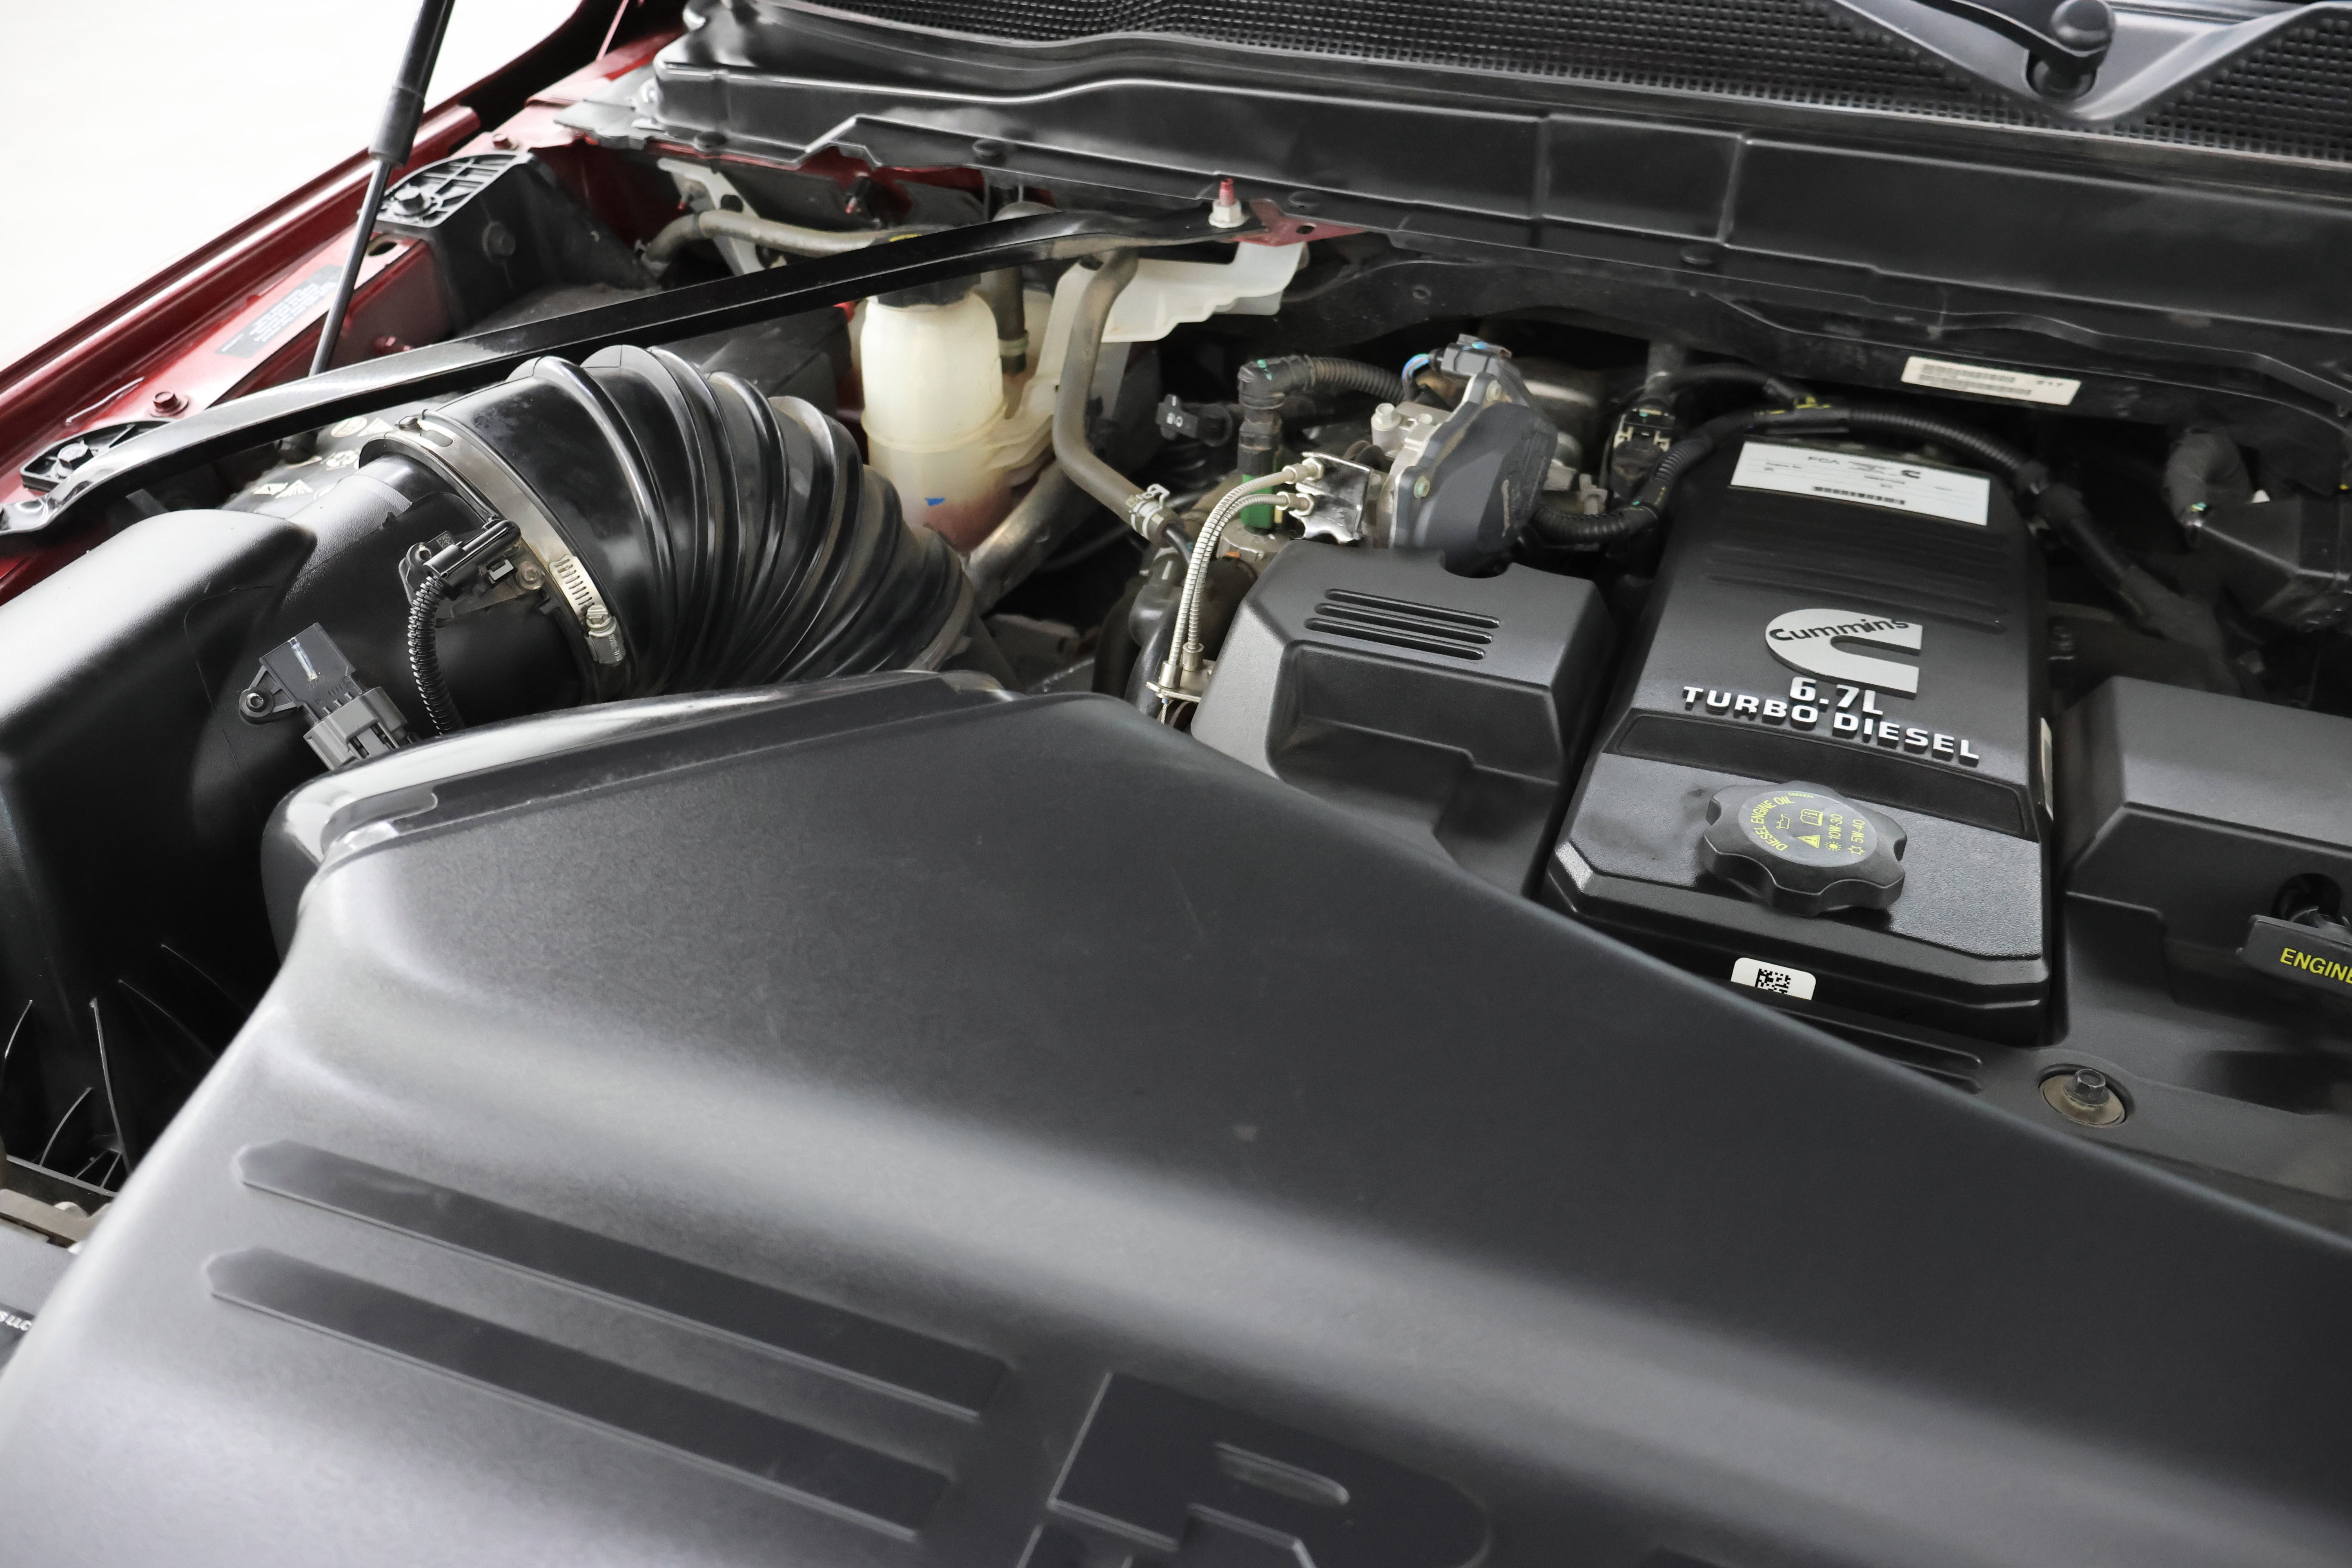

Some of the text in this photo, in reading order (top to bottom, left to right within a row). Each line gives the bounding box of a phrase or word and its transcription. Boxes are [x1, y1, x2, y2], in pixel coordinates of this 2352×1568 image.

[1768, 618, 1910, 642] Cummins
[1789, 676, 1883, 716] 6.7L
[1683, 686, 1980, 767] TURBO DIESEL
[1751, 796, 1796, 851] DIESEL ENGINE OIL
[1828, 814, 1843, 839] 10W-30
[1851, 819, 1866, 843] 5W-40
